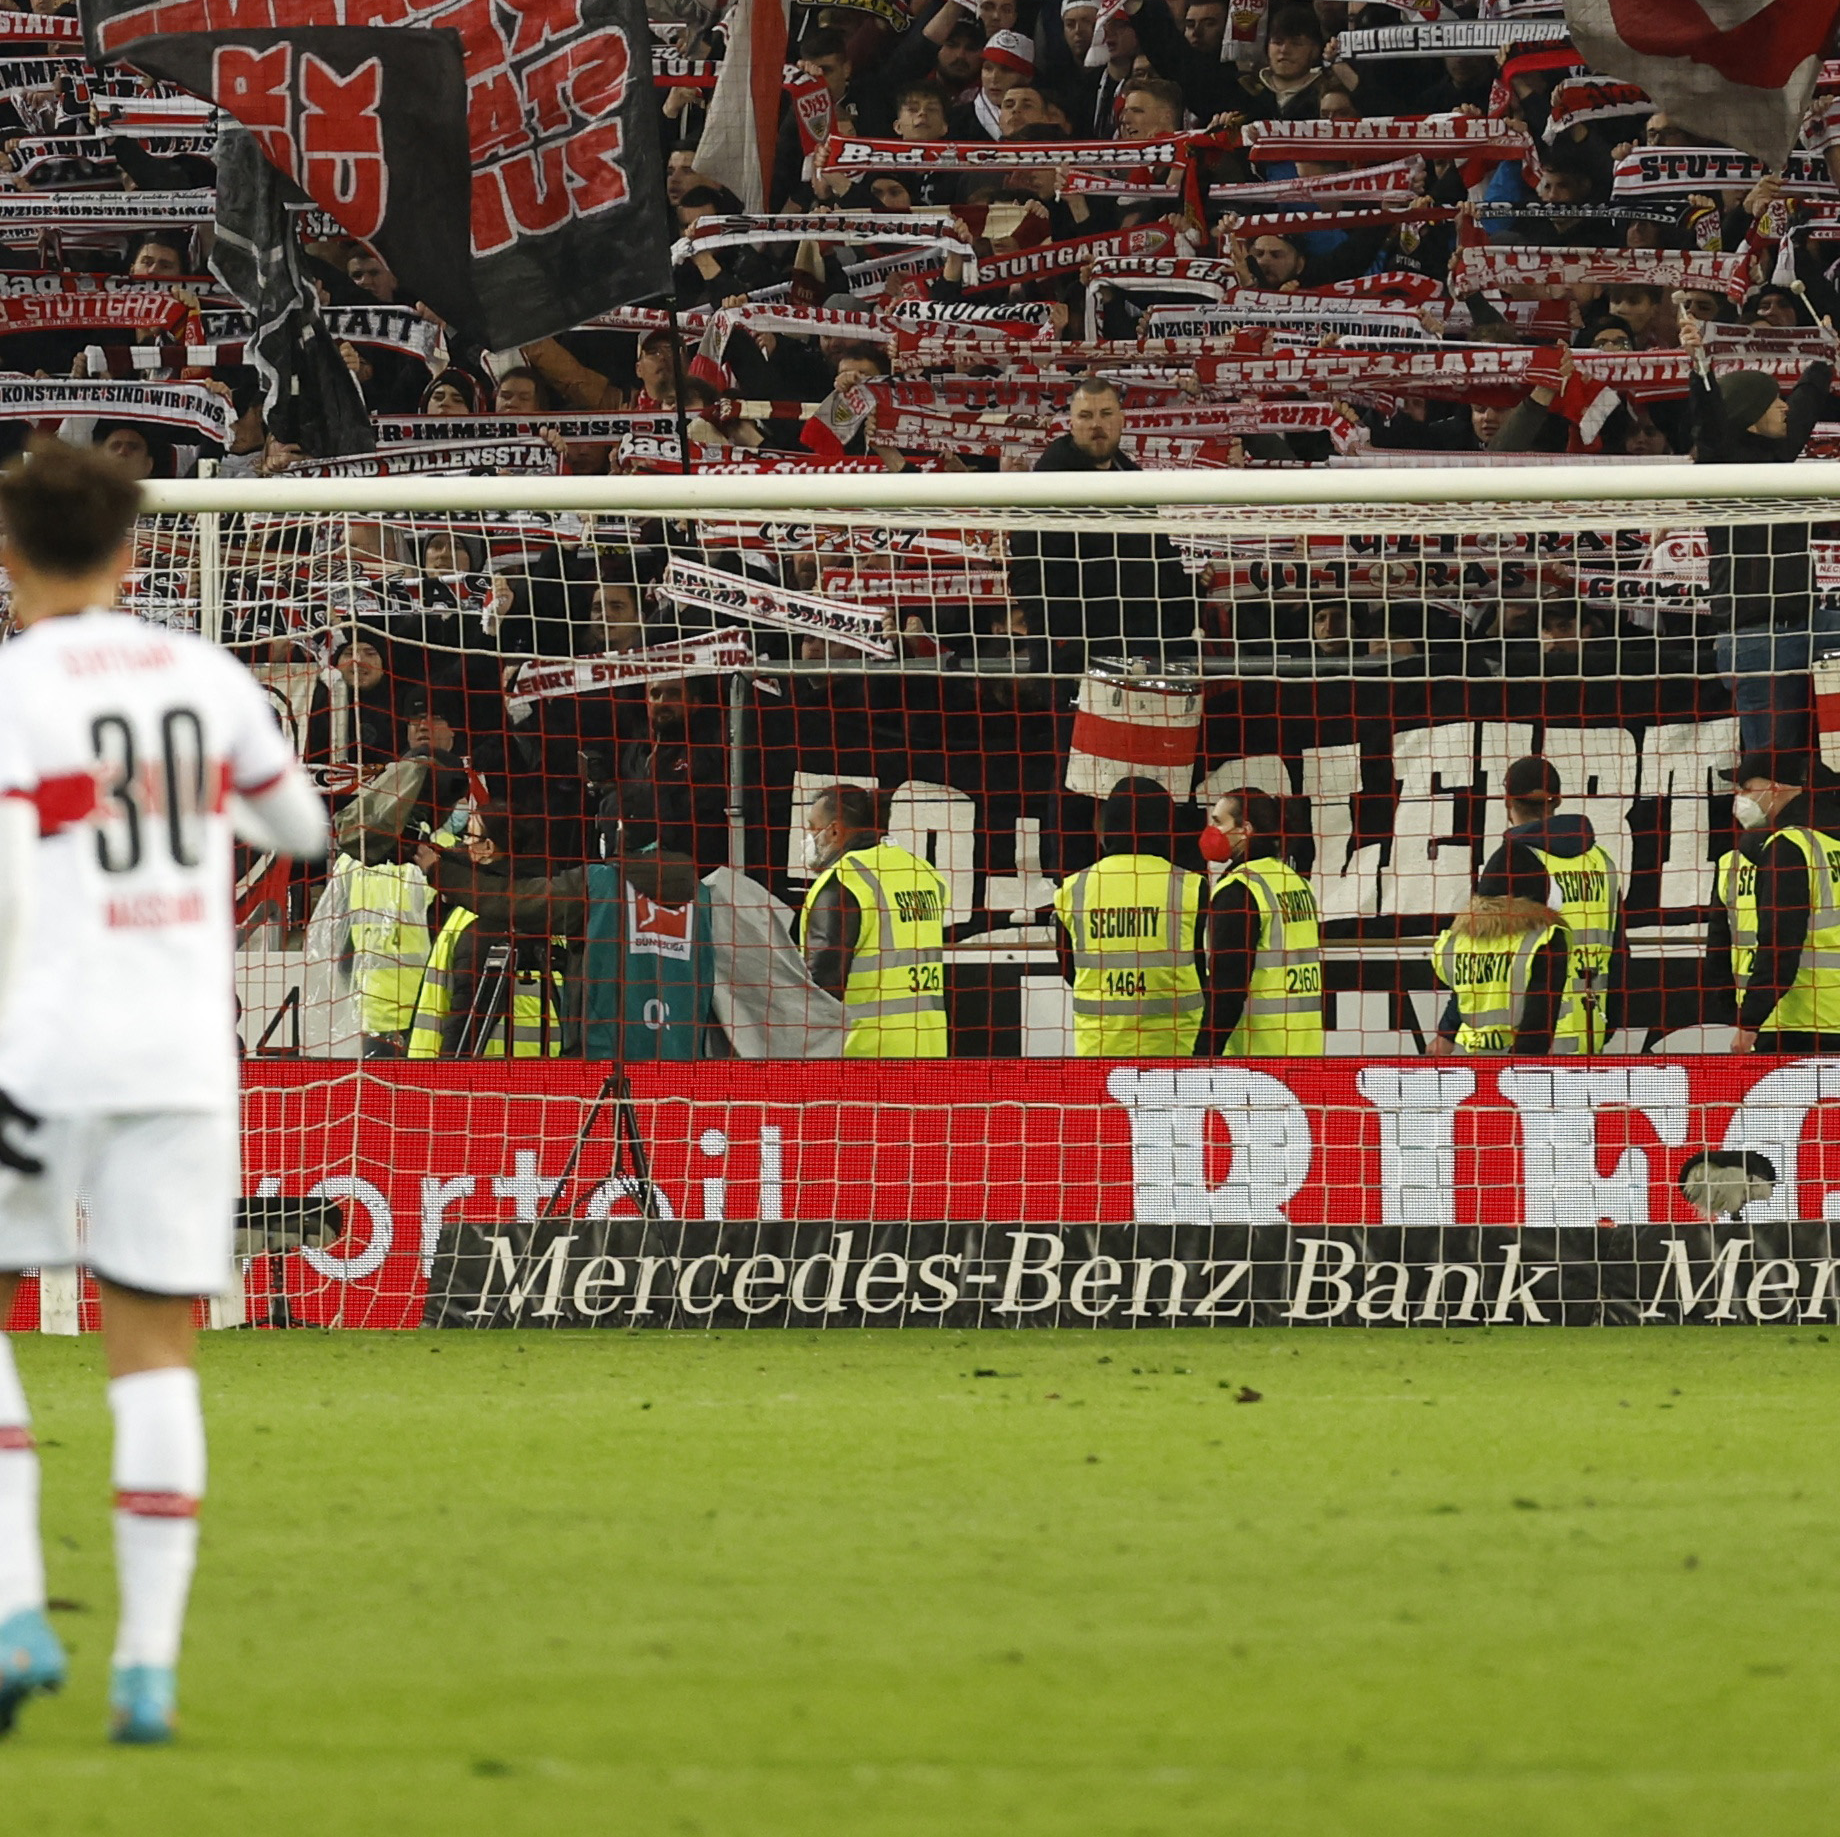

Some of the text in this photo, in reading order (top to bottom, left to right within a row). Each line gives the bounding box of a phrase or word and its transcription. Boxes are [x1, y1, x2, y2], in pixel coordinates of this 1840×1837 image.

[836, 141, 1176, 167] Bad Cannstatt
[980, 237, 1121, 282] STUTTGART
[22, 294, 179, 321] STUTTGART
[2, 386, 99, 406] KONSTANTE
[101, 384, 145, 405] SIND
[149, 386, 185, 409] WIR
[418, 415, 634, 440] IMMER WEISS
[321, 458, 377, 480] UND
[90, 705, 210, 874] 30
[1089, 905, 1160, 940] SECURITY
[1454, 953, 1513, 984] SECURITY
[1105, 972, 1146, 998] 1464
[466, 1230, 1562, 1328] Mercedes-Benz Bank
